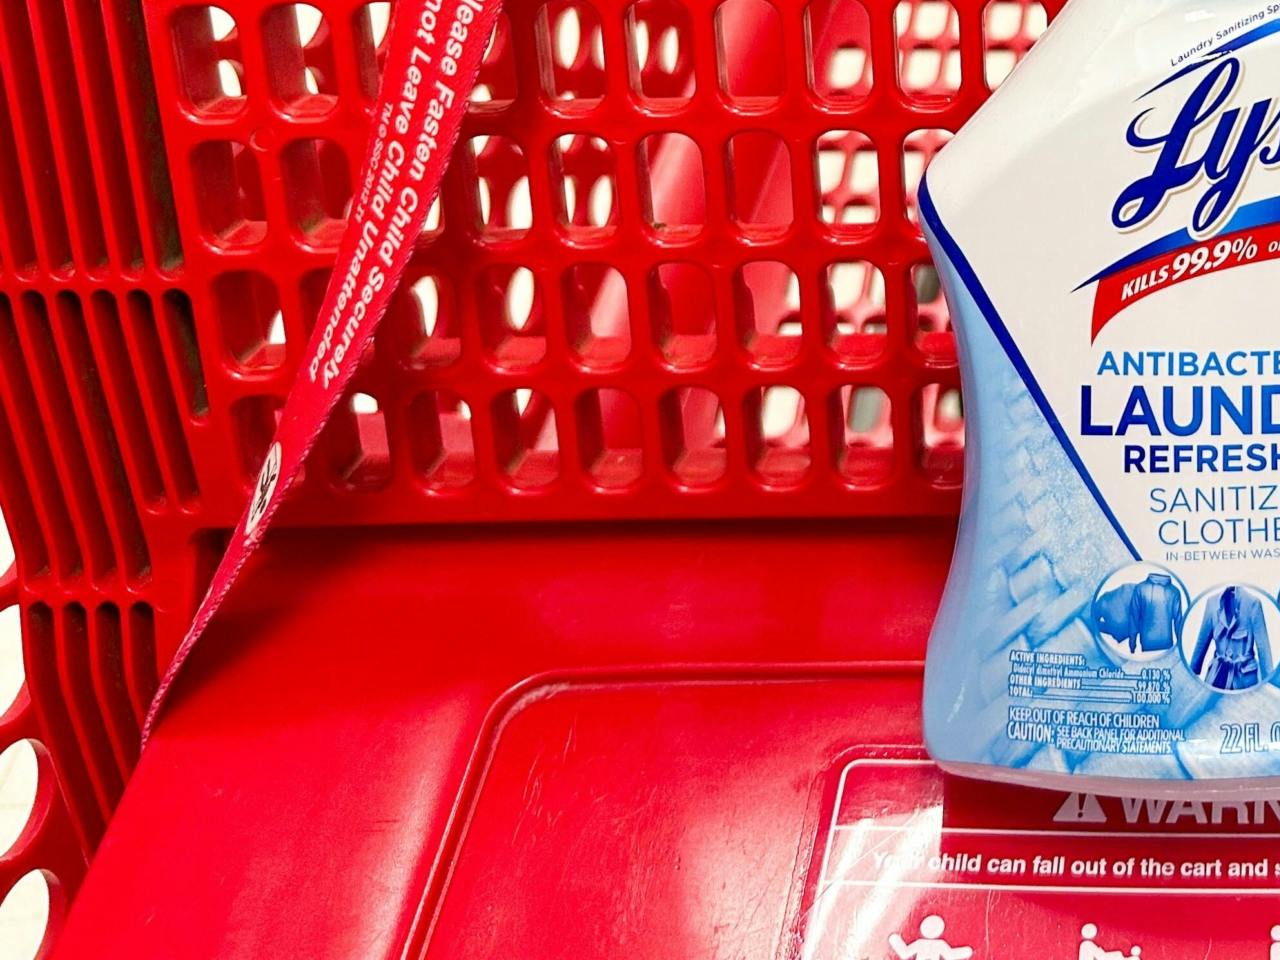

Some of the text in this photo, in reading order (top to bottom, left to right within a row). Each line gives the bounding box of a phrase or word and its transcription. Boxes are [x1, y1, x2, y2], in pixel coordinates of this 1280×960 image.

[1171, 37, 1214, 67] Laundry
[1216, 11, 1265, 41] Sanitizing
[395, 47, 432, 135] Leave
[410, 81, 455, 180] Fasten
[370, 140, 405, 220] Child
[378, 187, 419, 267] Child
[1121, 265, 1170, 301] KILLS
[1171, 236, 1258, 280] 99.9%
[309, 221, 380, 383] Unattended
[322, 267, 386, 390] Securely
[1009, 650, 1035, 662] ACTIVE
[1009, 673, 1033, 685] OTHER
[1034, 675, 1081, 689] INGREDIENTS
[1007, 721, 1185, 743] CAUTION: SEE BACK PANEL FOR ADDITIONAL
[1009, 706, 1160, 728] KEEP OUT OF REACH OF CHILDREN
[1057, 738, 1121, 752] PRECAUTIONARY
[1219, 723, 1243, 754] 22
[928, 853, 981, 873] child
[987, 855, 1026, 874] can
[1033, 855, 1064, 875] fall
[1071, 857, 1106, 876] out
[1112, 857, 1135, 876] of
[1140, 858, 1175, 877] the
[1180, 858, 1222, 877] cart
[1228, 858, 1268, 877] and
